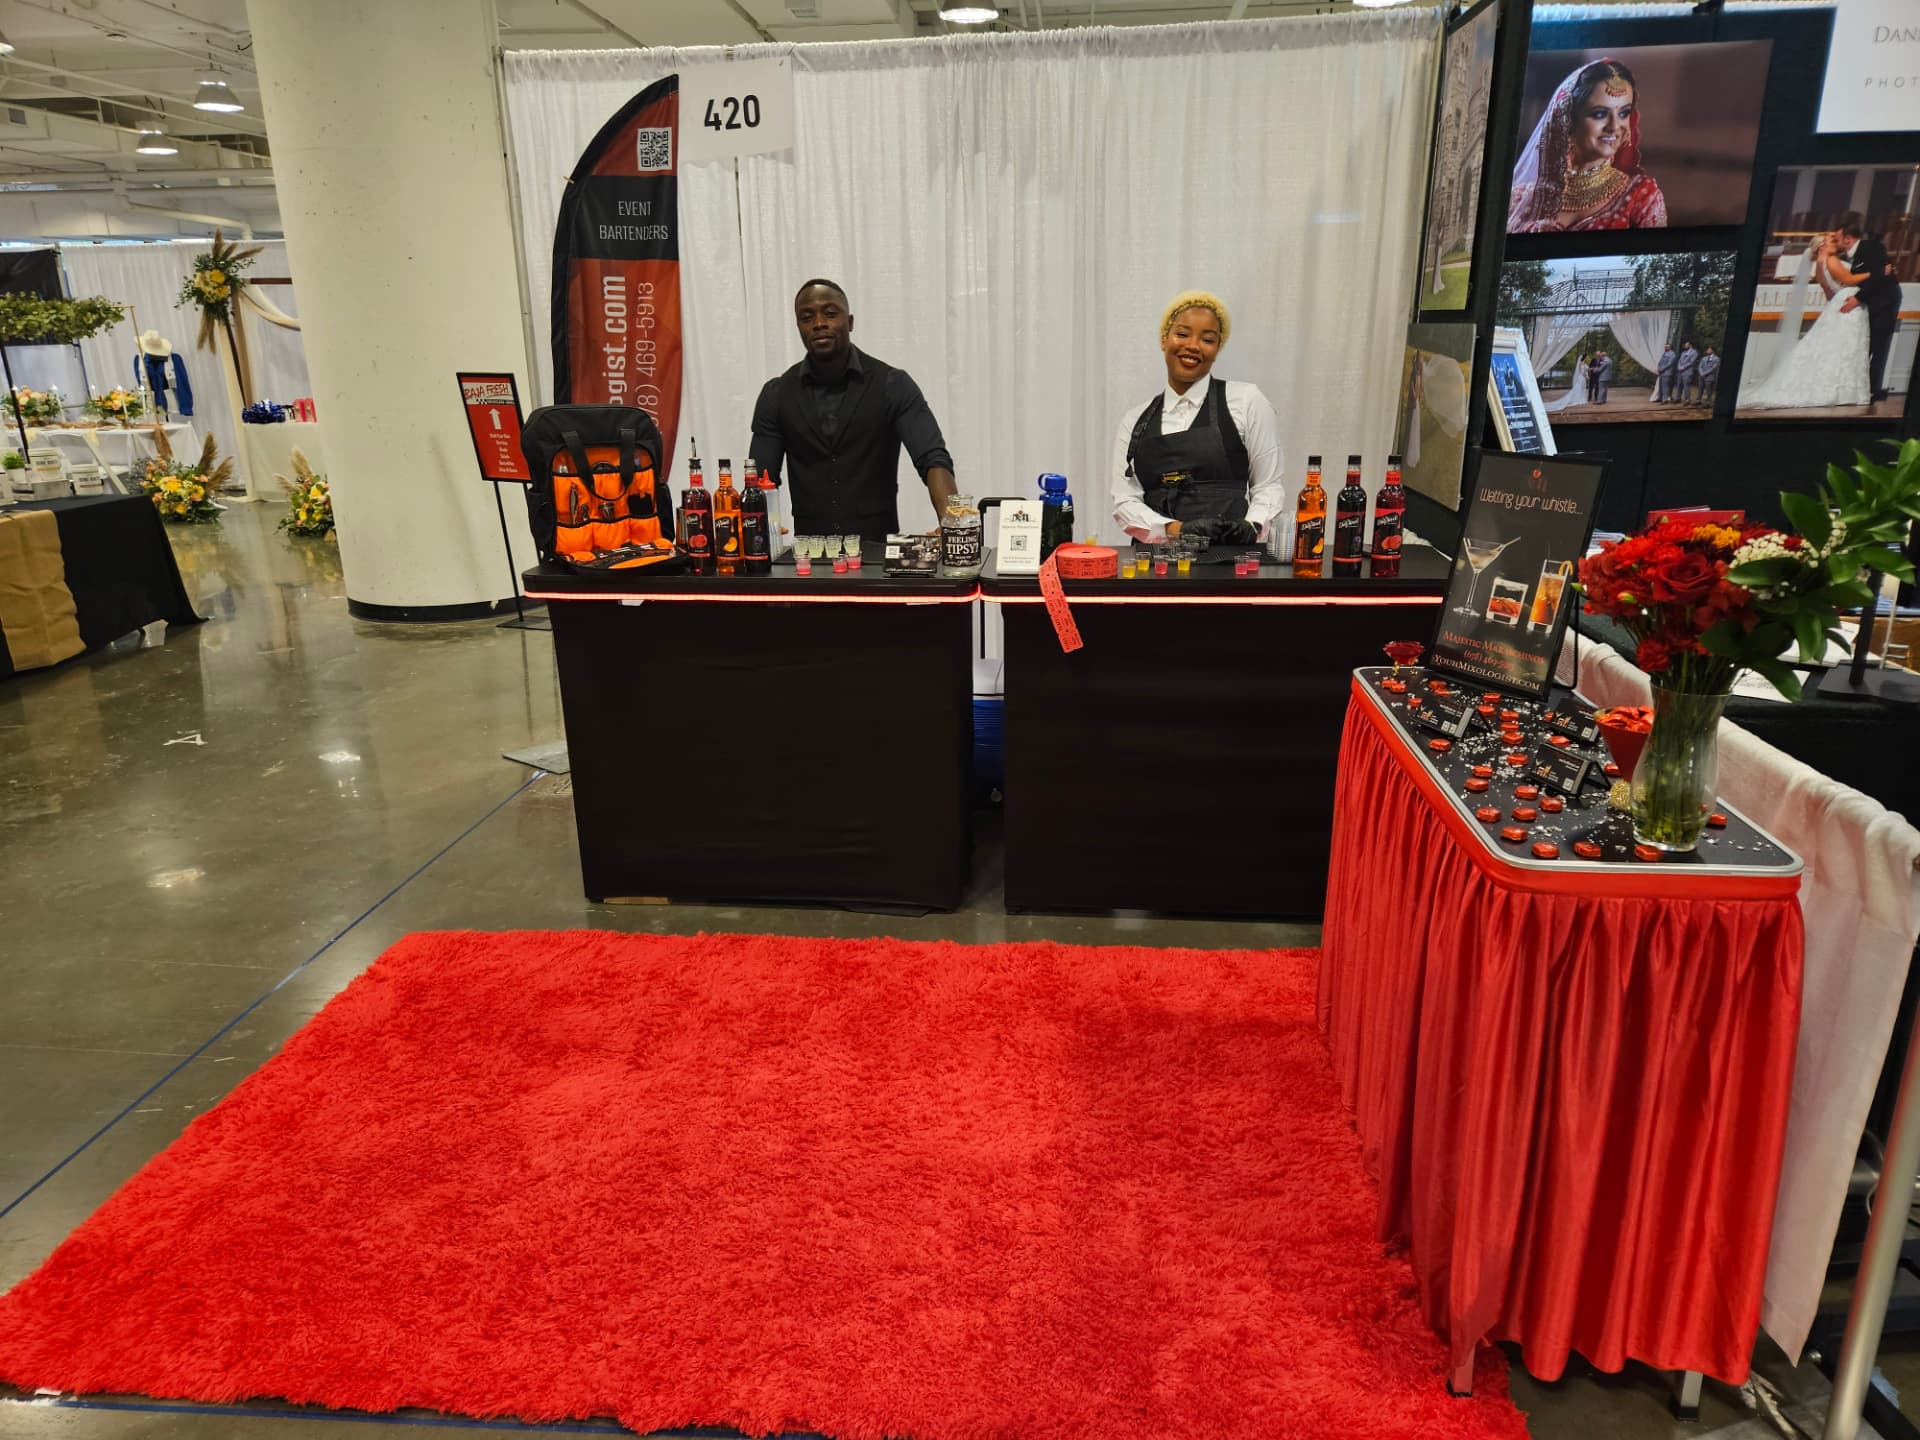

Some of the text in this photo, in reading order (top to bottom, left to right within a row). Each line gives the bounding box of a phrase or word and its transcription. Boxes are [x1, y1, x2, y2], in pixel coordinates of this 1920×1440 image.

[1874, 25, 1920, 43] DAN
[704, 94, 760, 131] 420
[618, 200, 652, 216] EVENT
[599, 224, 668, 241] BARTENDERS
[635, 281, 656, 377] 469-5913
[486, 384, 510, 395] FRESH
[1480, 488, 1514, 510] Wetting
[1514, 495, 1541, 511] your
[946, 542, 979, 555] TIPSY?
